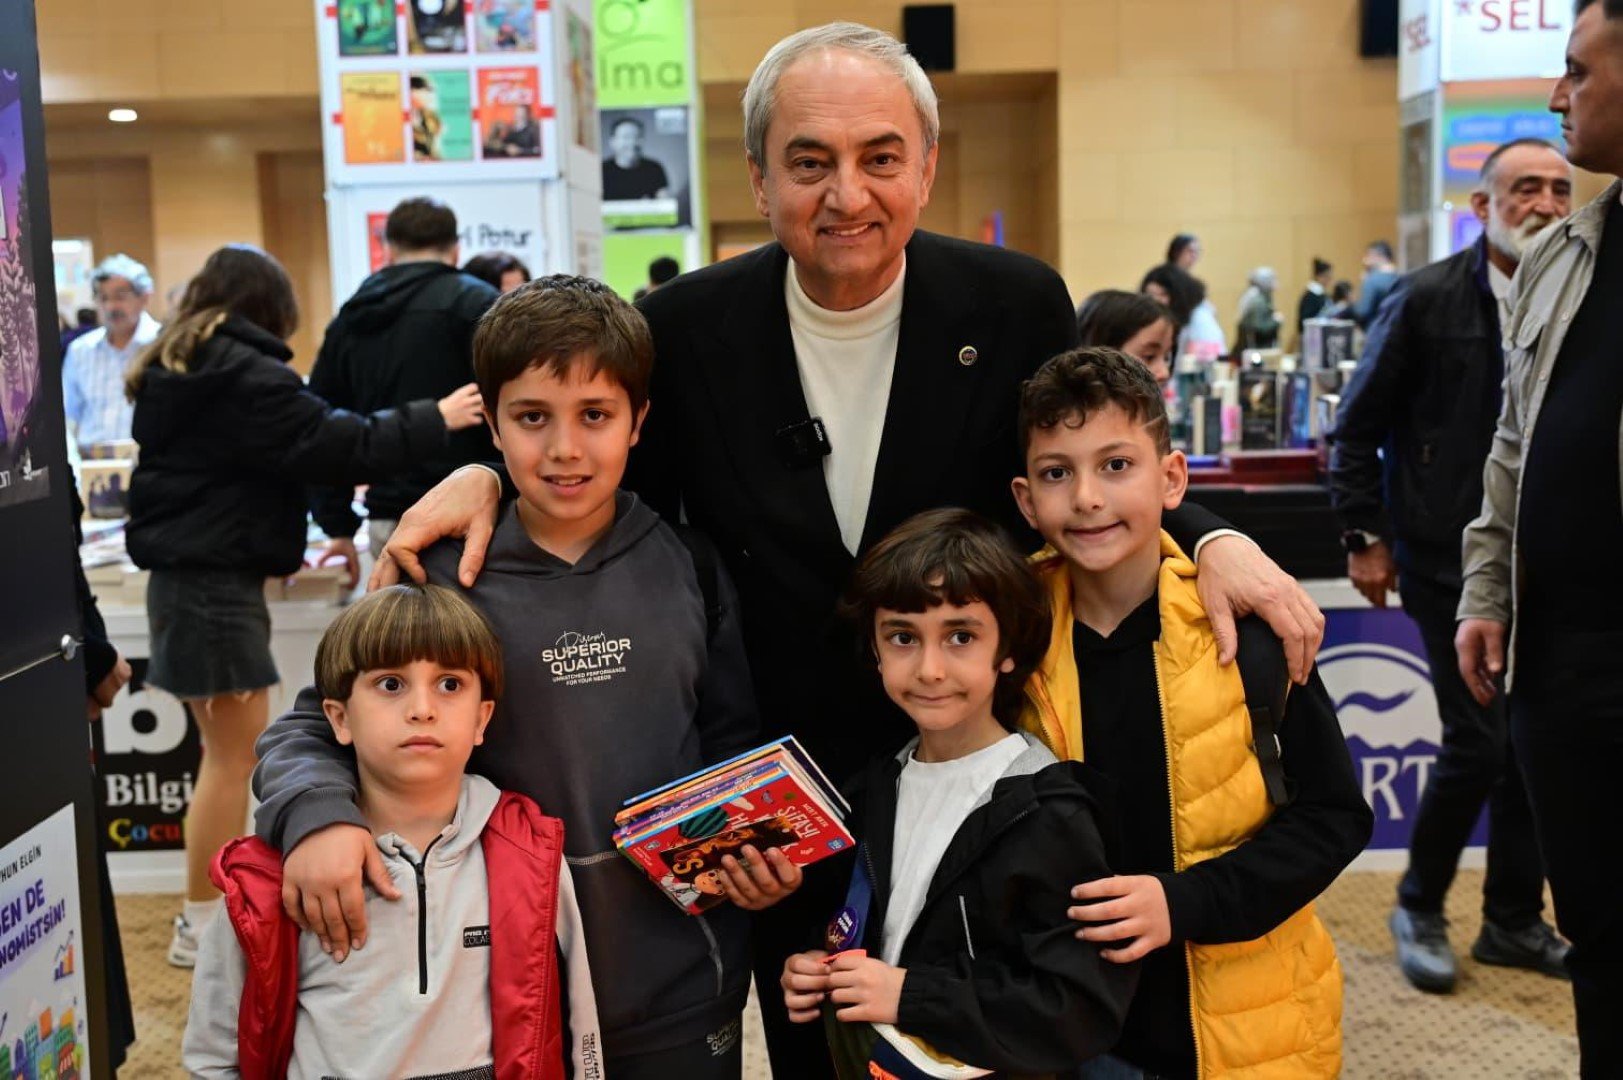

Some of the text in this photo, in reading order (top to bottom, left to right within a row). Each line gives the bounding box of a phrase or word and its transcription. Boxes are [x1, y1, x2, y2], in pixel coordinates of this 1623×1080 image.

[1480, 0, 1562, 32] SEL
[542, 638, 631, 662] SUPERIOR
[551, 652, 624, 675] QUALITY
[578, 677, 592, 685] YOUR
[586, 666, 626, 678] PERFORMANCE
[105, 771, 194, 814] Bilgi
[109, 818, 187, 848] Çocu
[0, 844, 42, 882] HUN ELGİN
[0, 878, 45, 937] EN DE
